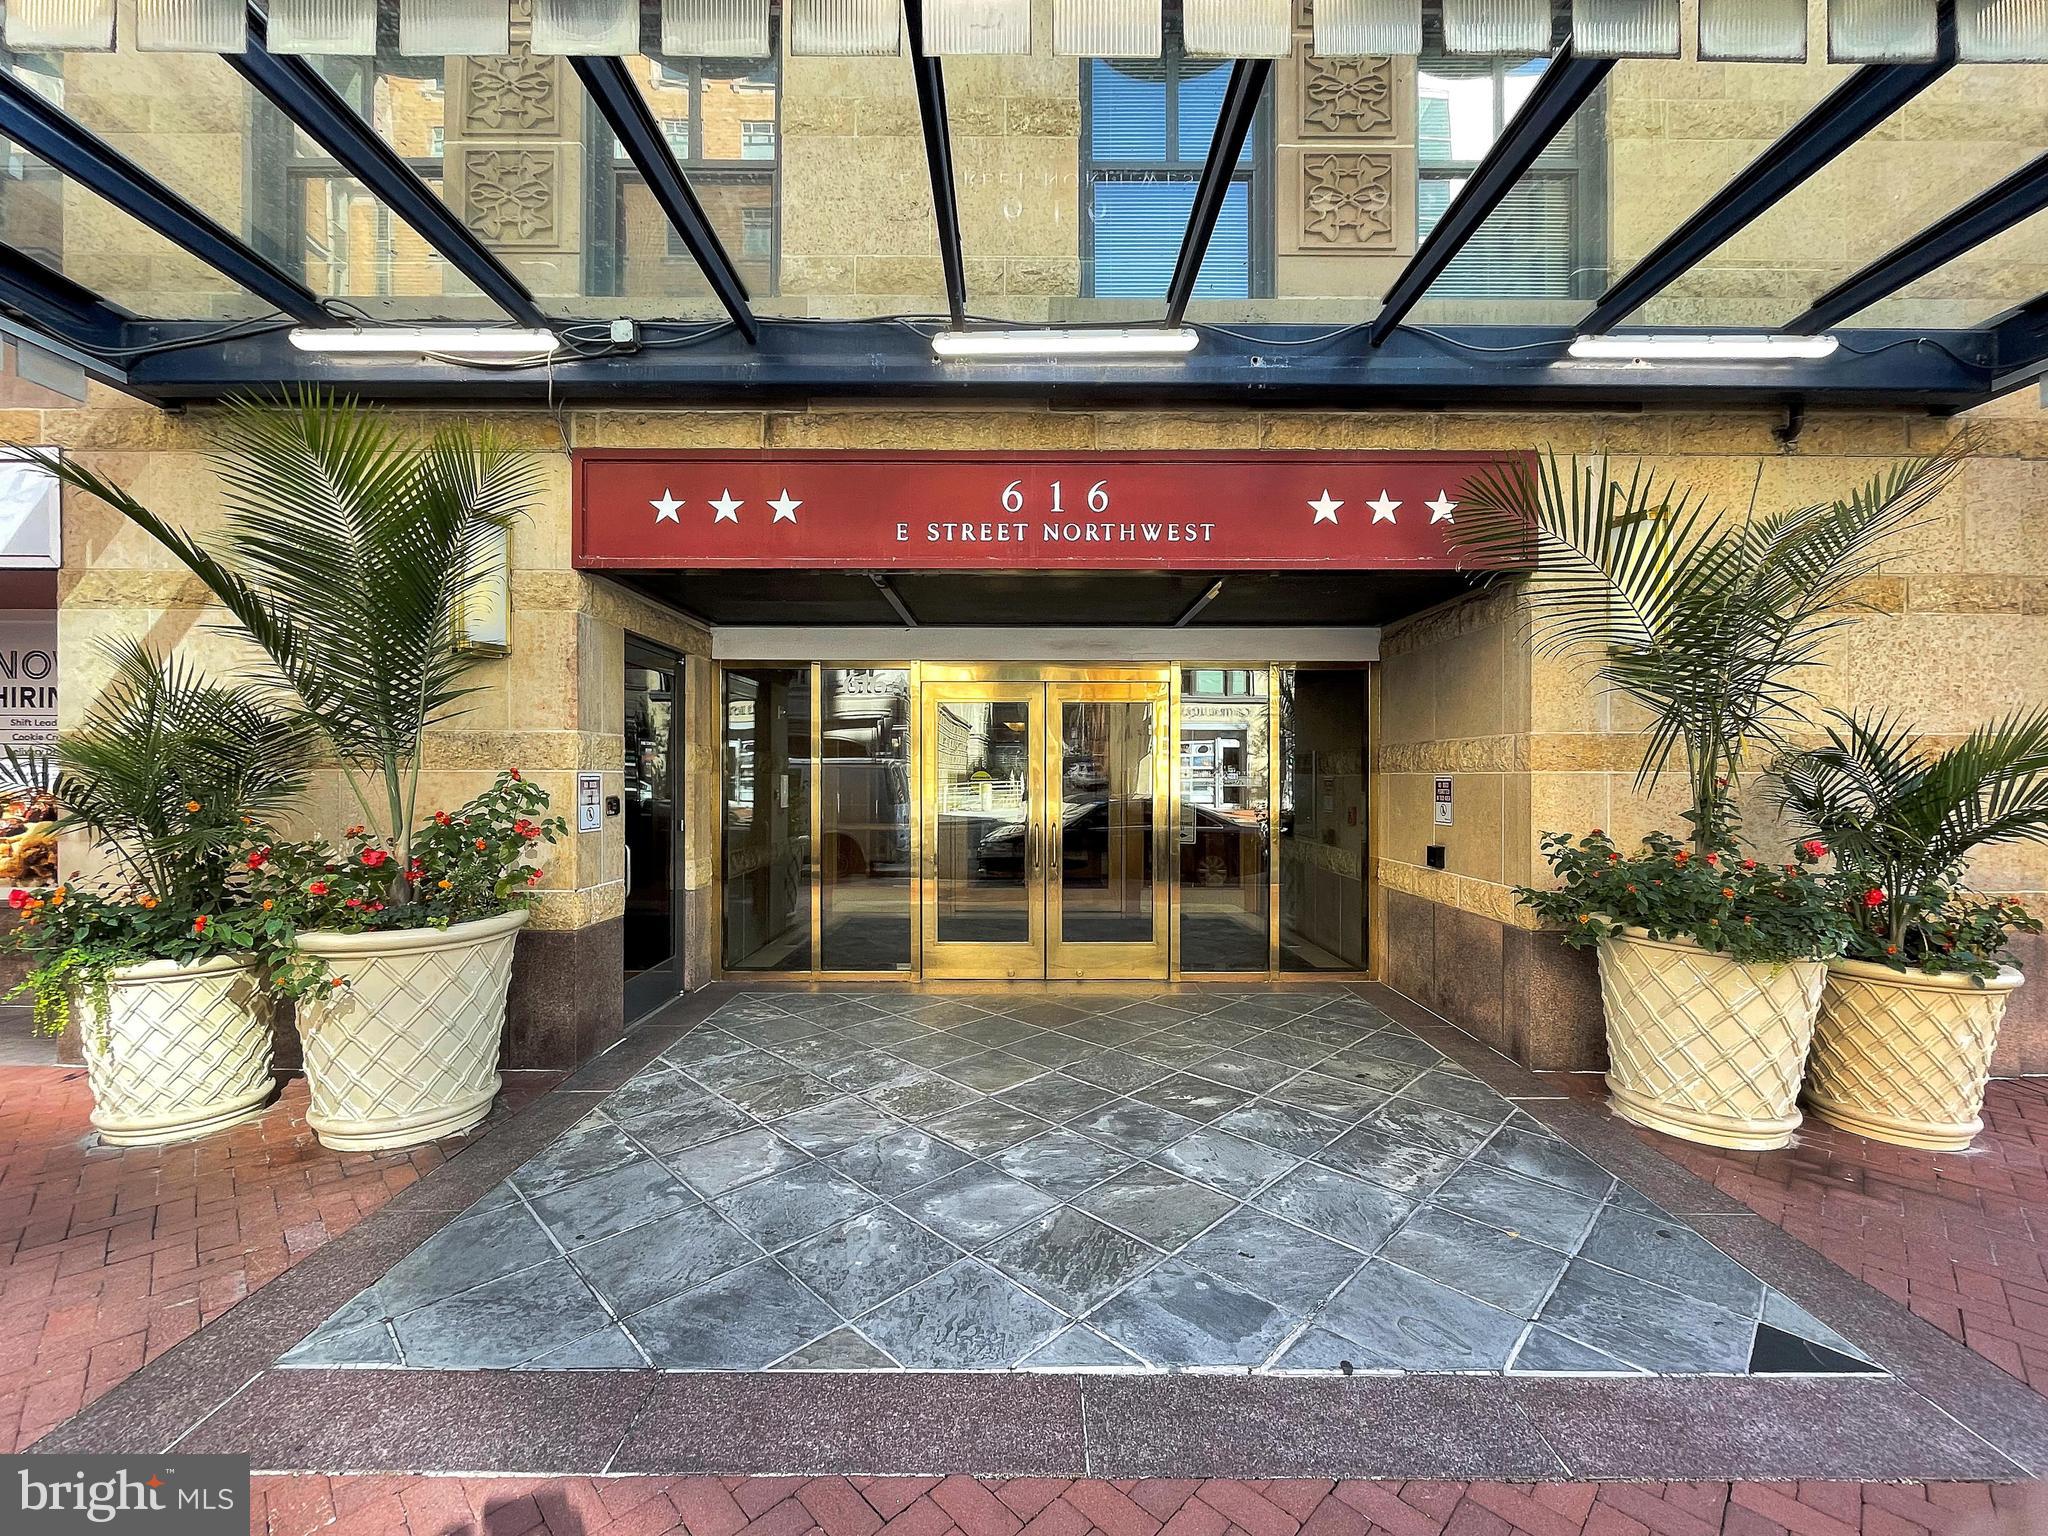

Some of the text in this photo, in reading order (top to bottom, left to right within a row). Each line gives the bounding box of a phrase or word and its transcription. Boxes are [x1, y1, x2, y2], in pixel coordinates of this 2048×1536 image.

[1001, 480, 1109, 513] 616
[896, 523, 1216, 541] E STREET NORTHWEST
[0, 650, 57, 679] NO
[10, 718, 32, 727] Shift
[12, 733, 44, 741] Cookie
